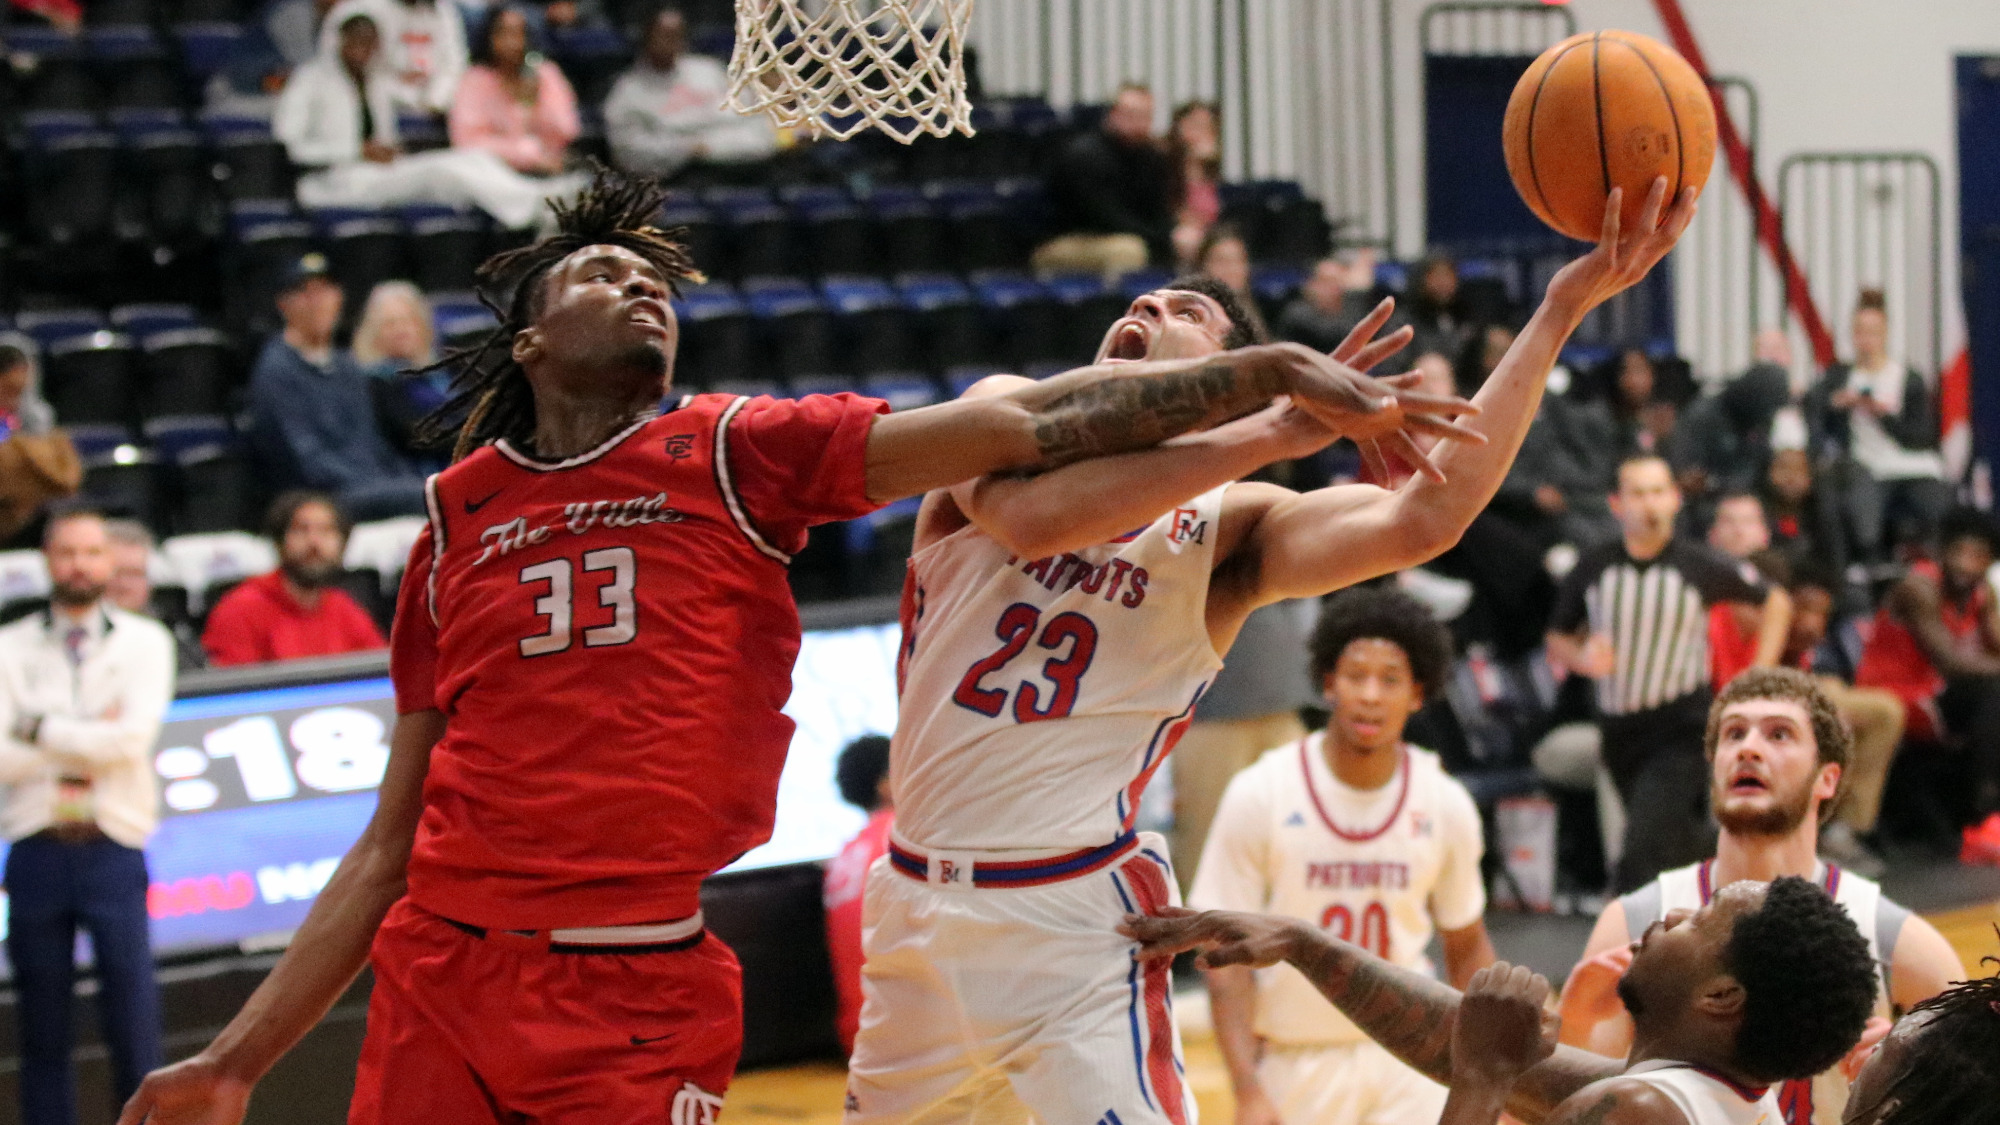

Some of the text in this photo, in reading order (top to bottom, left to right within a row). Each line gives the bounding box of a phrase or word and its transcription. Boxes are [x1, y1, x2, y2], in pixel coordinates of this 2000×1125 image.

[473, 491, 687, 567] The Ville
[518, 545, 637, 660] 33
[952, 601, 1099, 725] 23
[1305, 861, 1410, 892] PATRIOTS
